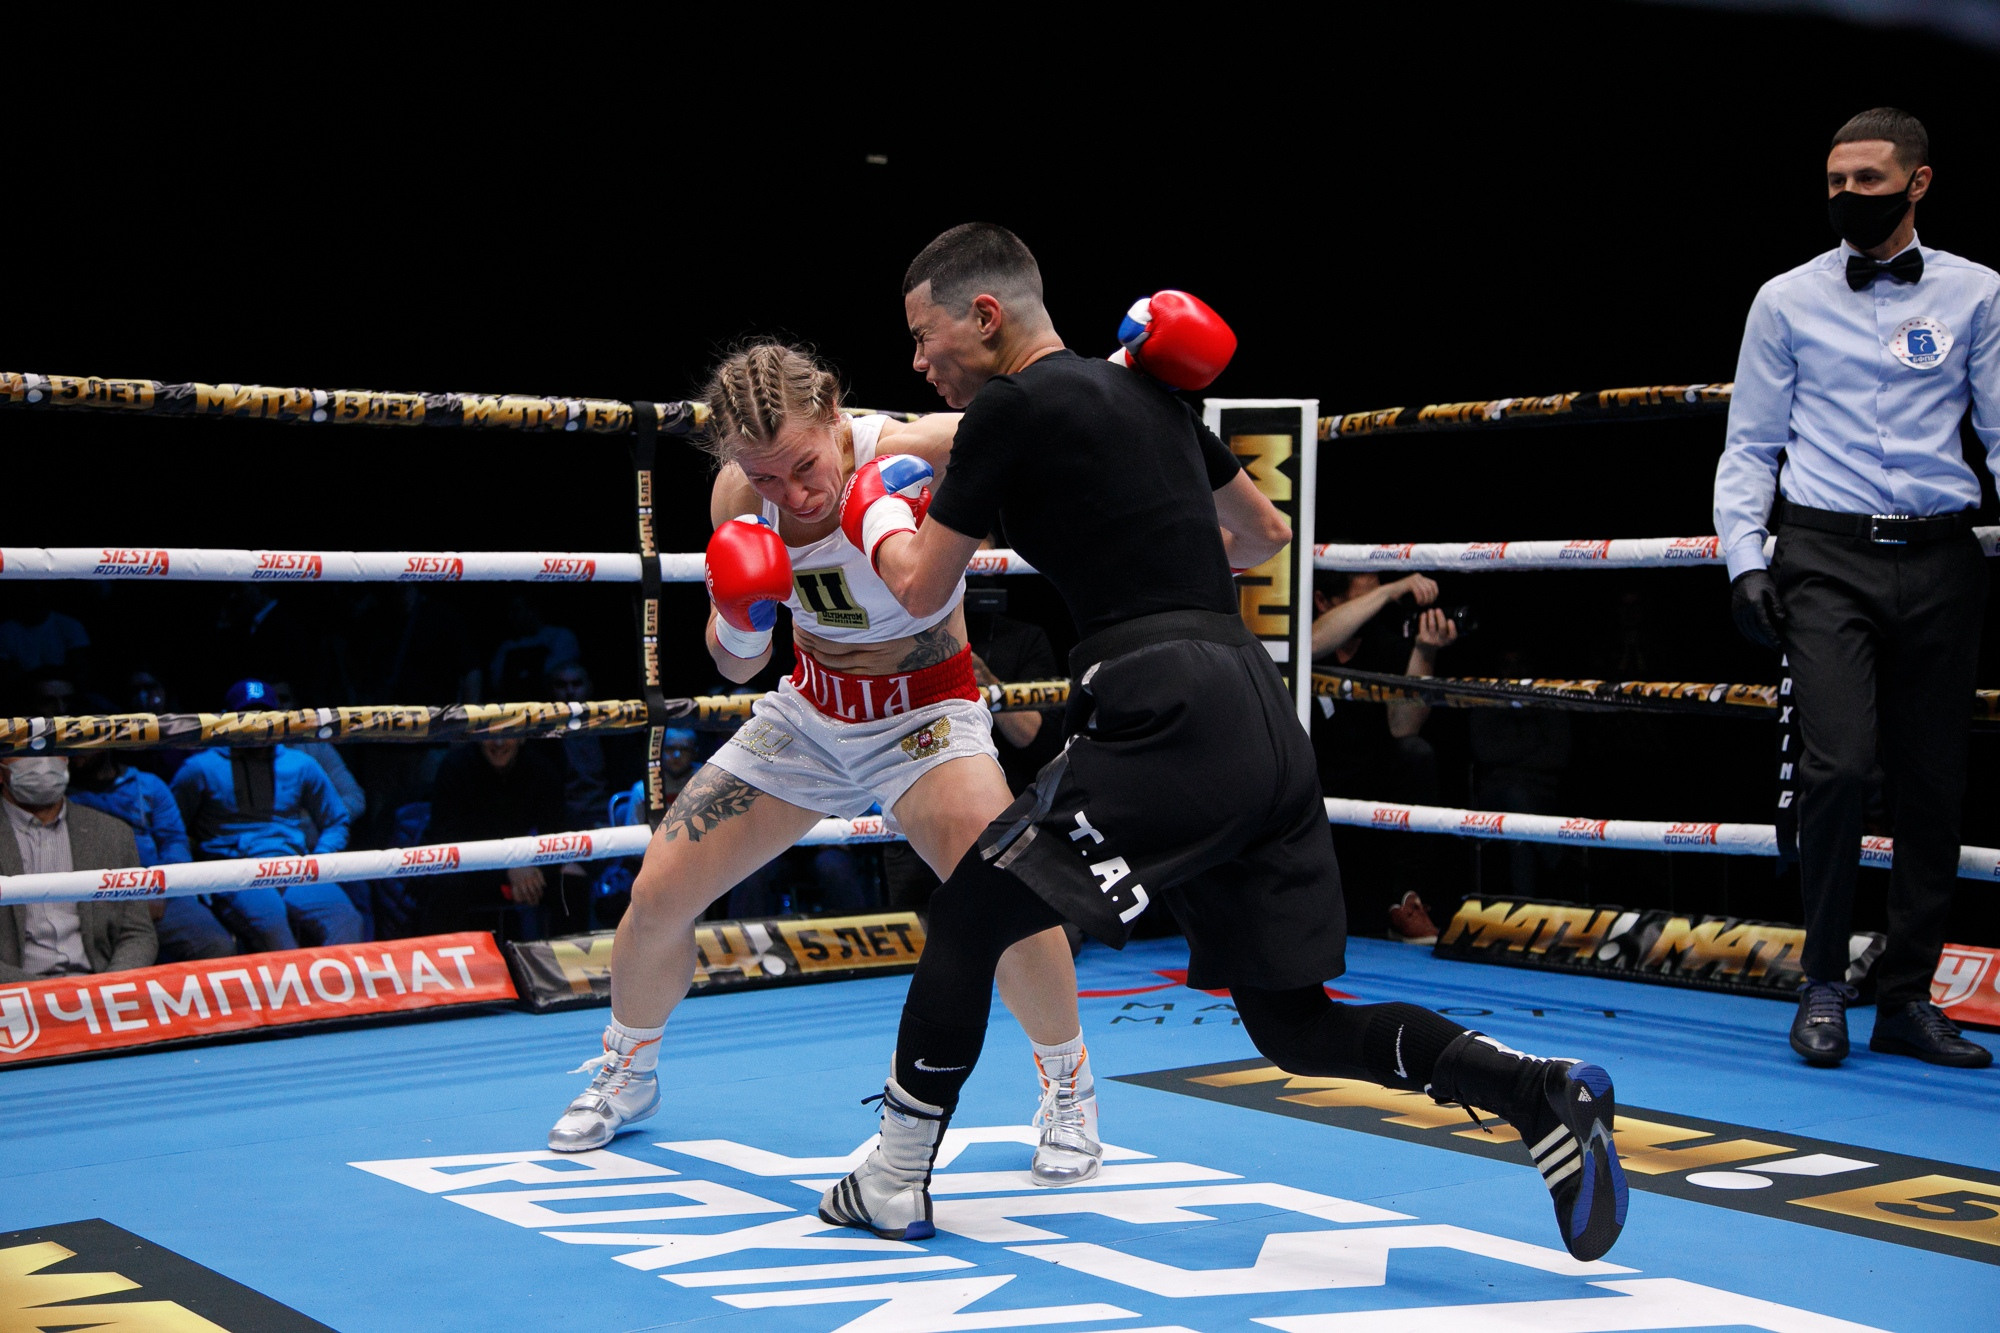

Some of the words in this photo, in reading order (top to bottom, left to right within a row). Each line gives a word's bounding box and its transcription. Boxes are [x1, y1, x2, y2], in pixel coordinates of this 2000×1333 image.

[194, 383, 329, 425] МАТЧ!
[99, 550, 169, 575] SIESTA
[1559, 549, 1594, 560] BOXING
[1664, 548, 1703, 559] BOXING
[93, 565, 149, 576] BOXING
[251, 570, 303, 579] BOXING
[257, 554, 322, 579] SIESTA
[404, 556, 463, 581] SIESTA
[539, 557, 596, 582] SIESTA
[791, 651, 914, 721] JULIA
[1371, 808, 1411, 830] SIESTA
[536, 835, 592, 857] SIESTA
[1664, 835, 1703, 845] BOXING
[255, 858, 319, 882] SIESTA
[401, 846, 460, 870] SIESTA
[98, 869, 166, 895] SIESTA
[801, 929, 832, 961] 5
[839, 923, 914, 961] ЛЕТ
[1439, 899, 1640, 961] МАТЧ!
[44, 946, 476, 1035] ЧЕМПИОНАТ
